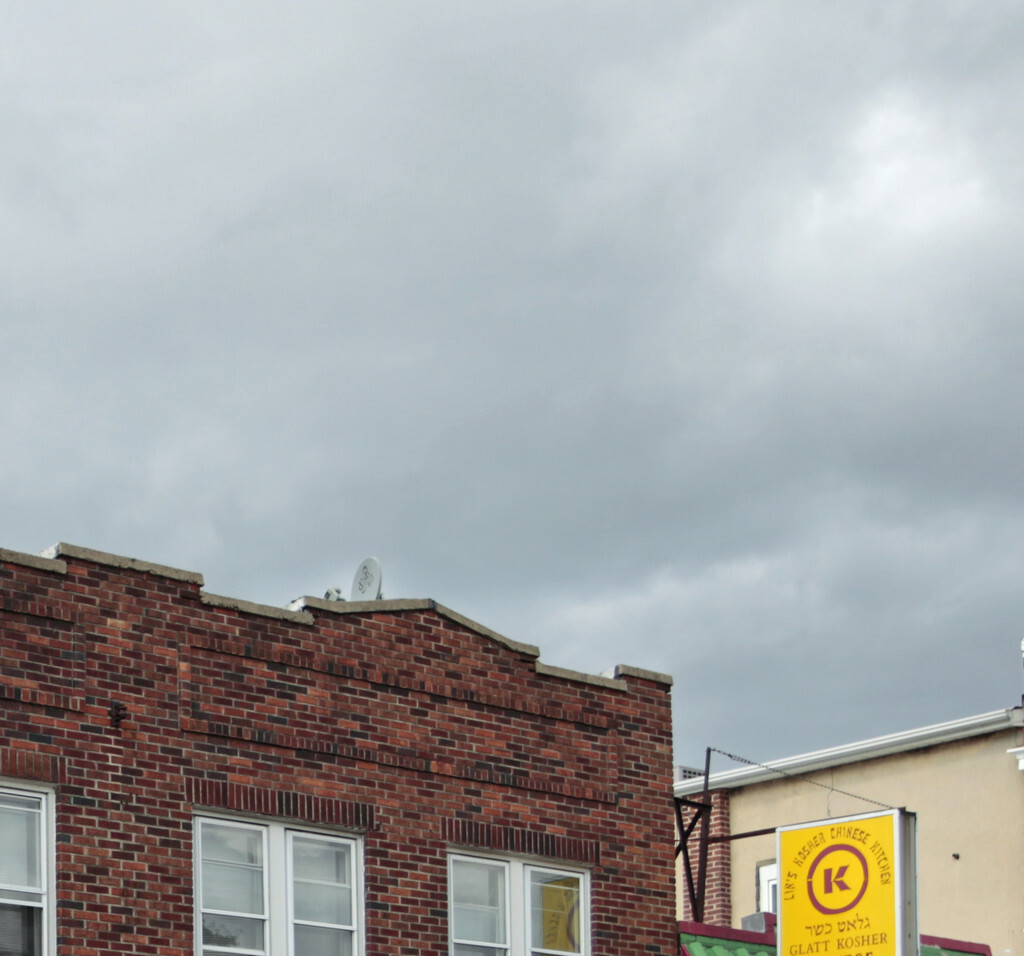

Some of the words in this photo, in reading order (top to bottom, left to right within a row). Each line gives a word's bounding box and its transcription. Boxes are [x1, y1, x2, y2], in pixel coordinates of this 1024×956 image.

[830, 826, 871, 845] CHINESE
[870, 840, 891, 885] KITCHEN
[789, 940, 830, 956] GLATT
[837, 932, 888, 950] KOSHER
